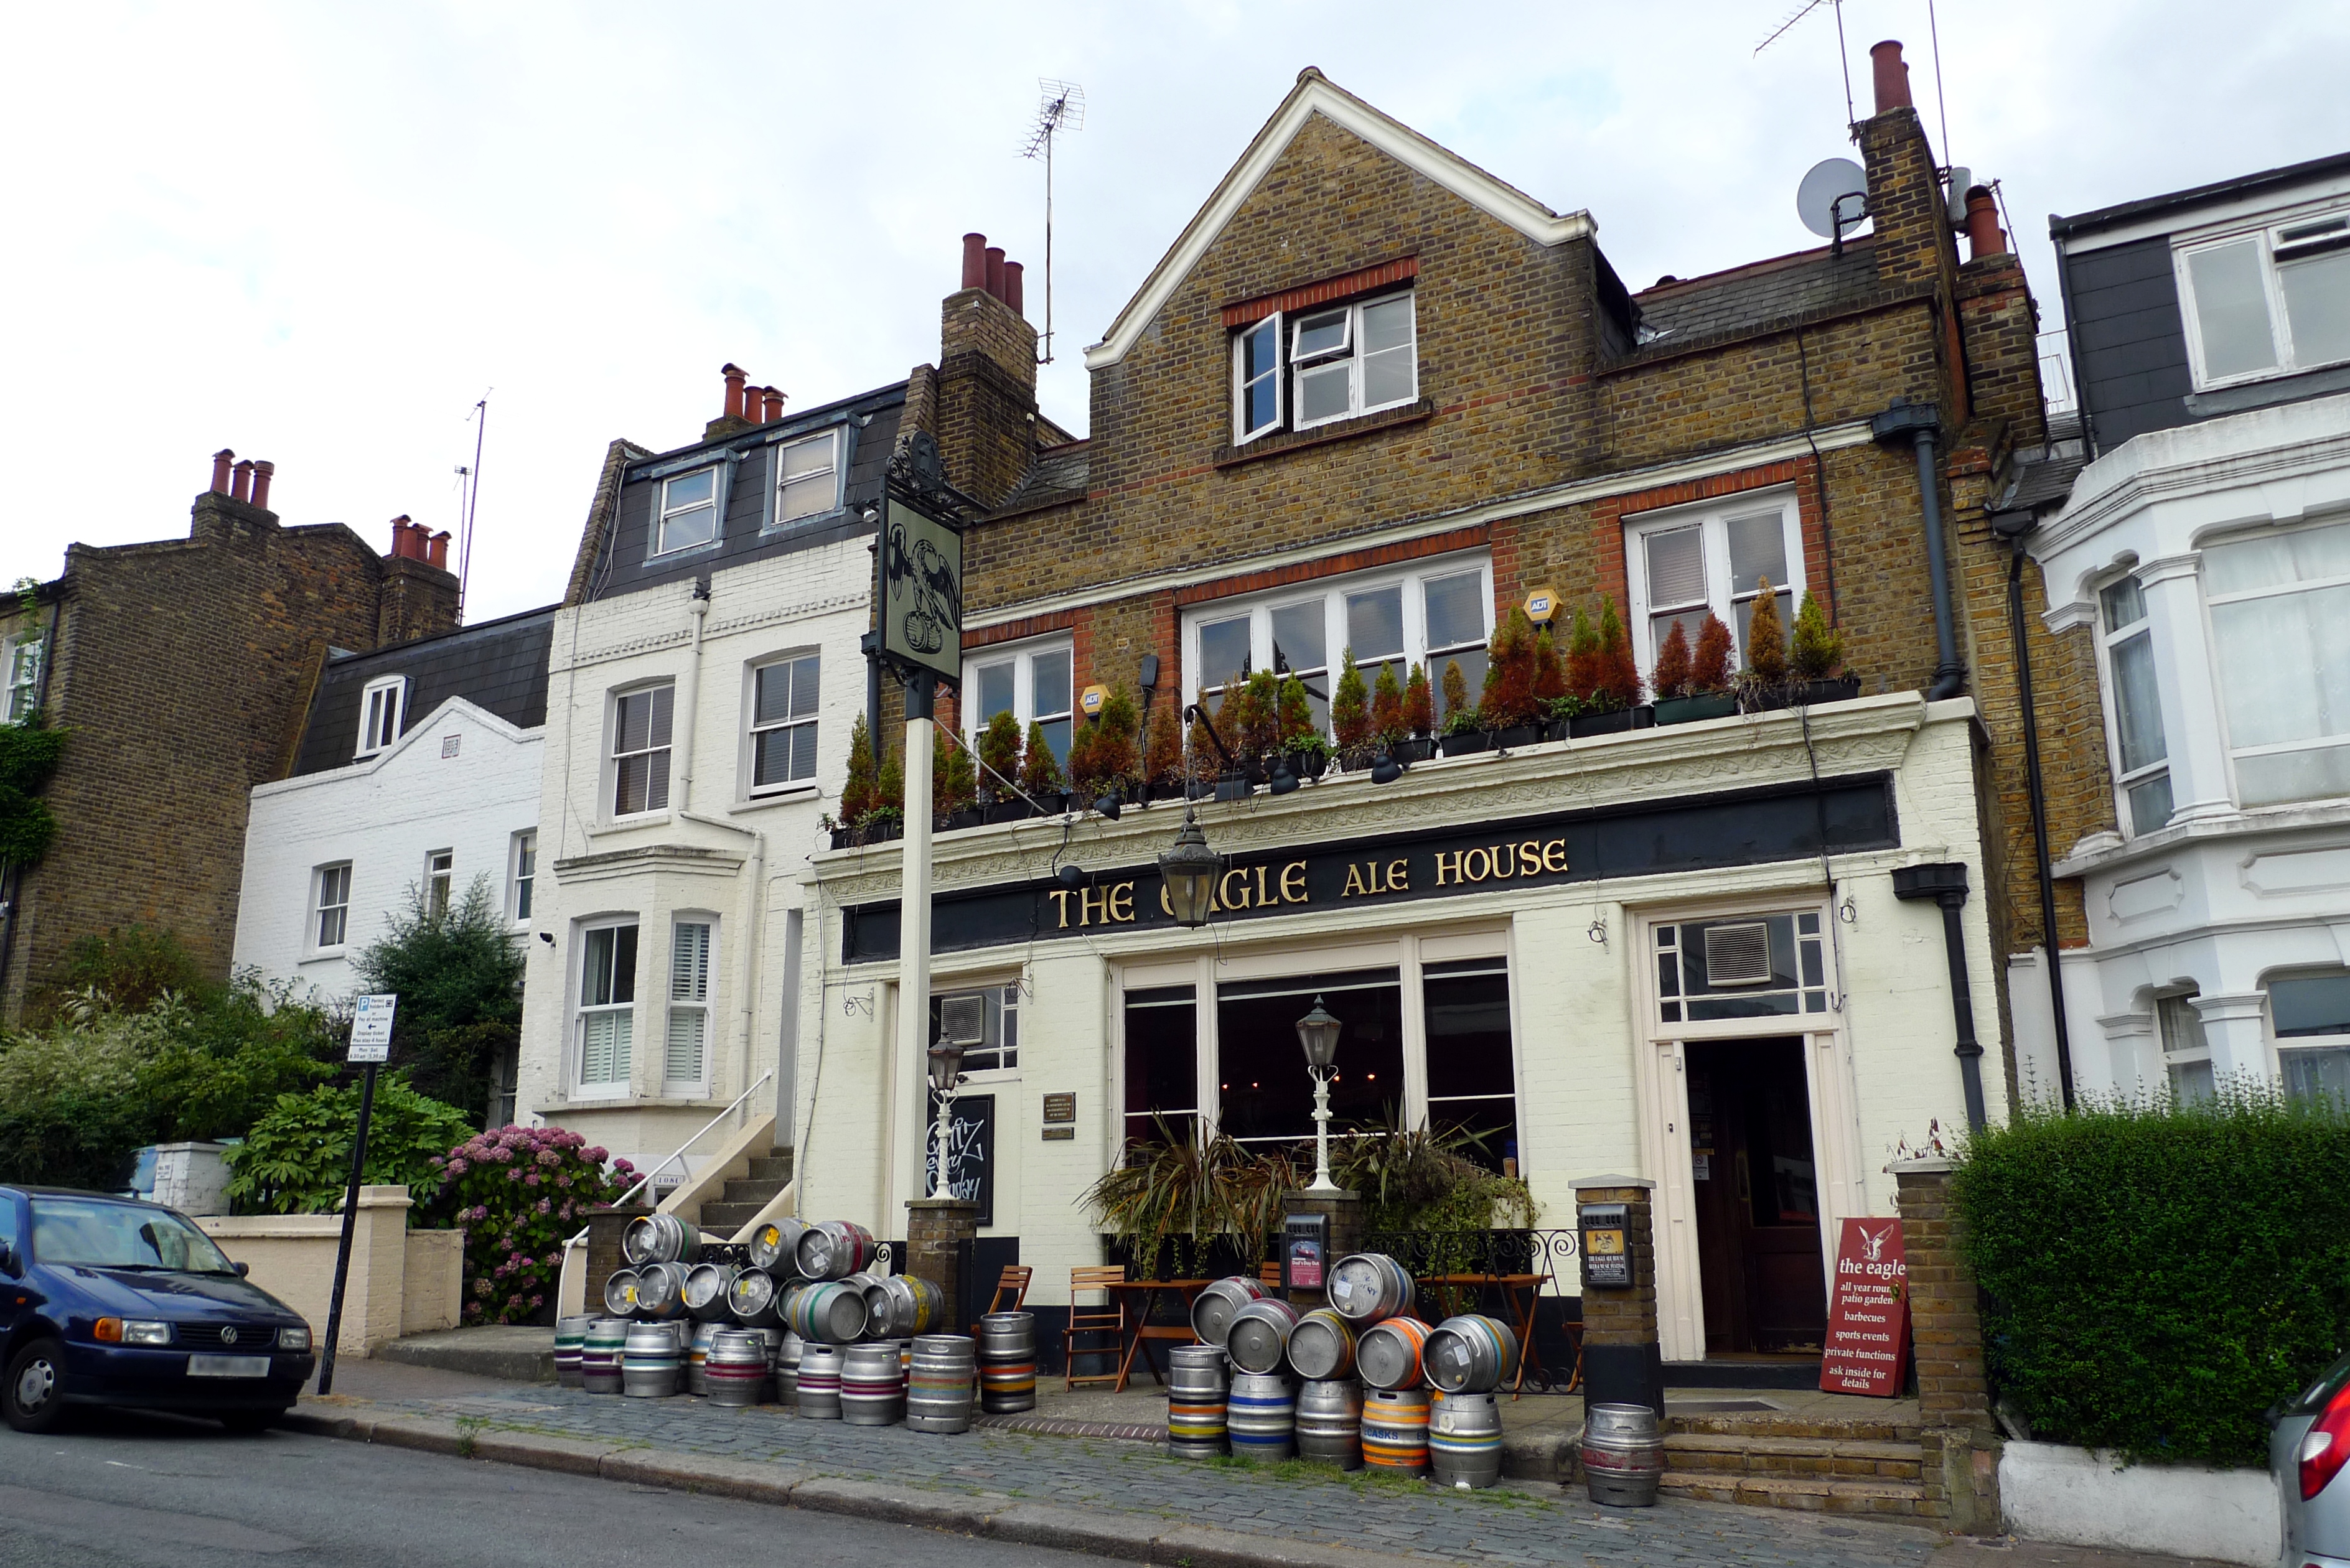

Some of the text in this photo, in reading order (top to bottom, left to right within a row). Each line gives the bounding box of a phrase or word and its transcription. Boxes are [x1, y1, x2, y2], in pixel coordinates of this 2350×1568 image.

[1531, 600, 1548, 610] ADT
[1085, 694, 1098, 704] ADT
[1049, 880, 1135, 928] THE
[1341, 858, 1409, 897] ALE
[1435, 838, 1568, 885] HOUSE
[360, 998, 368, 1010] P
[1840, 1258, 1906, 1280] the eagle
[1840, 1282, 1851, 1291] all
[1853, 1284, 1871, 1295] year
[1841, 1292, 1894, 1306] patio garden
[1844, 1311, 1886, 1323] barbecues
[1835, 1330, 1890, 1342] sports events
[1825, 1346, 1896, 1361] private functions
[1828, 1366, 1886, 1379] ask inside for
[1842, 1377, 1870, 1389] details
